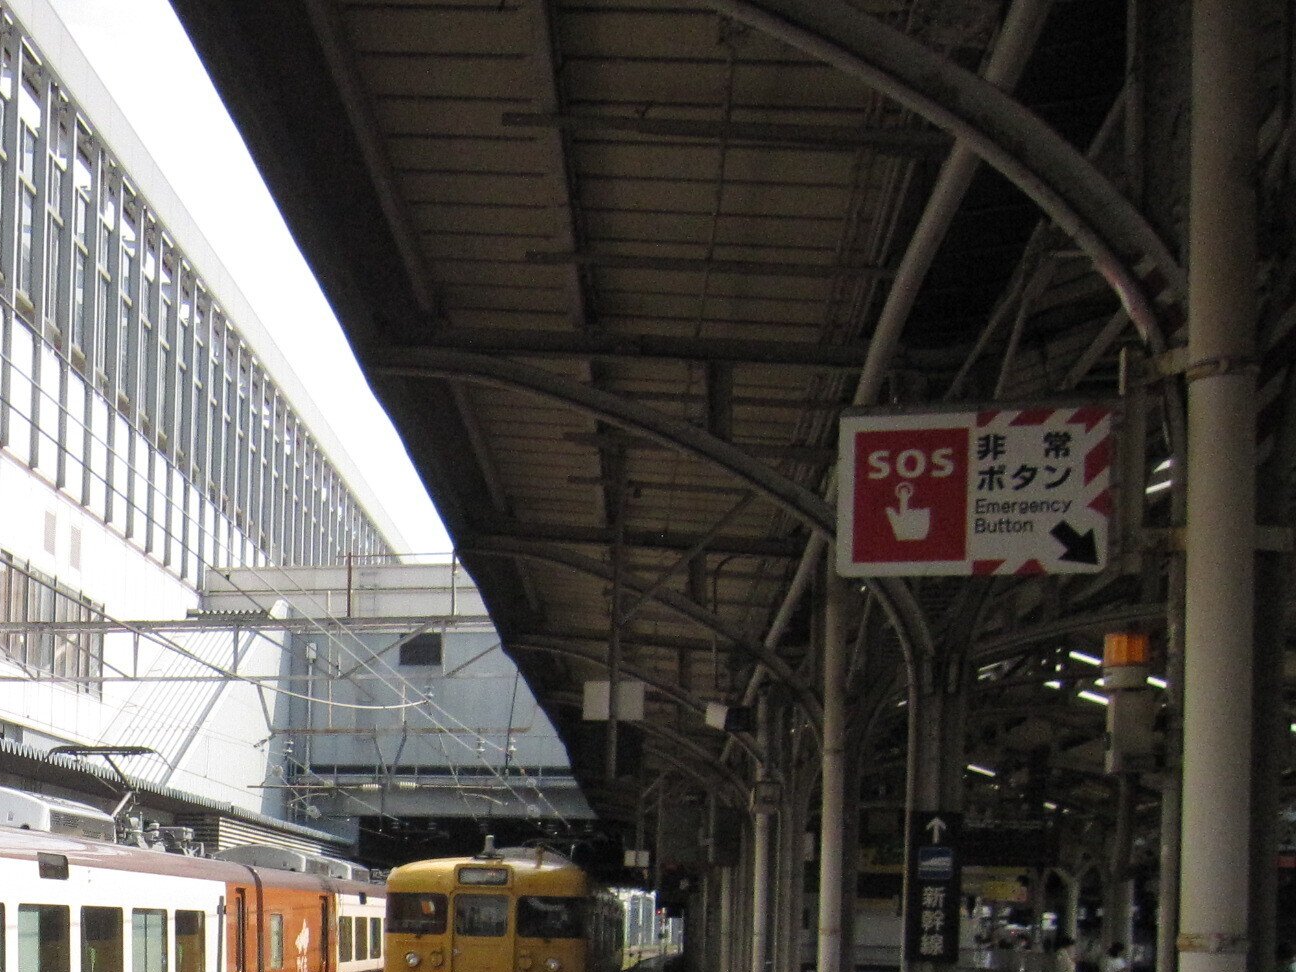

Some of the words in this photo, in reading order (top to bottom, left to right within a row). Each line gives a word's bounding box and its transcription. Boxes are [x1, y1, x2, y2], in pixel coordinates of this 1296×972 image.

[977, 431, 1072, 459] 非常
[867, 447, 955, 480] SOS
[977, 464, 1072, 491] ボタン
[974, 498, 1071, 516] Emergency
[974, 517, 1034, 534] Button
[920, 886, 946, 955] 新幹線
